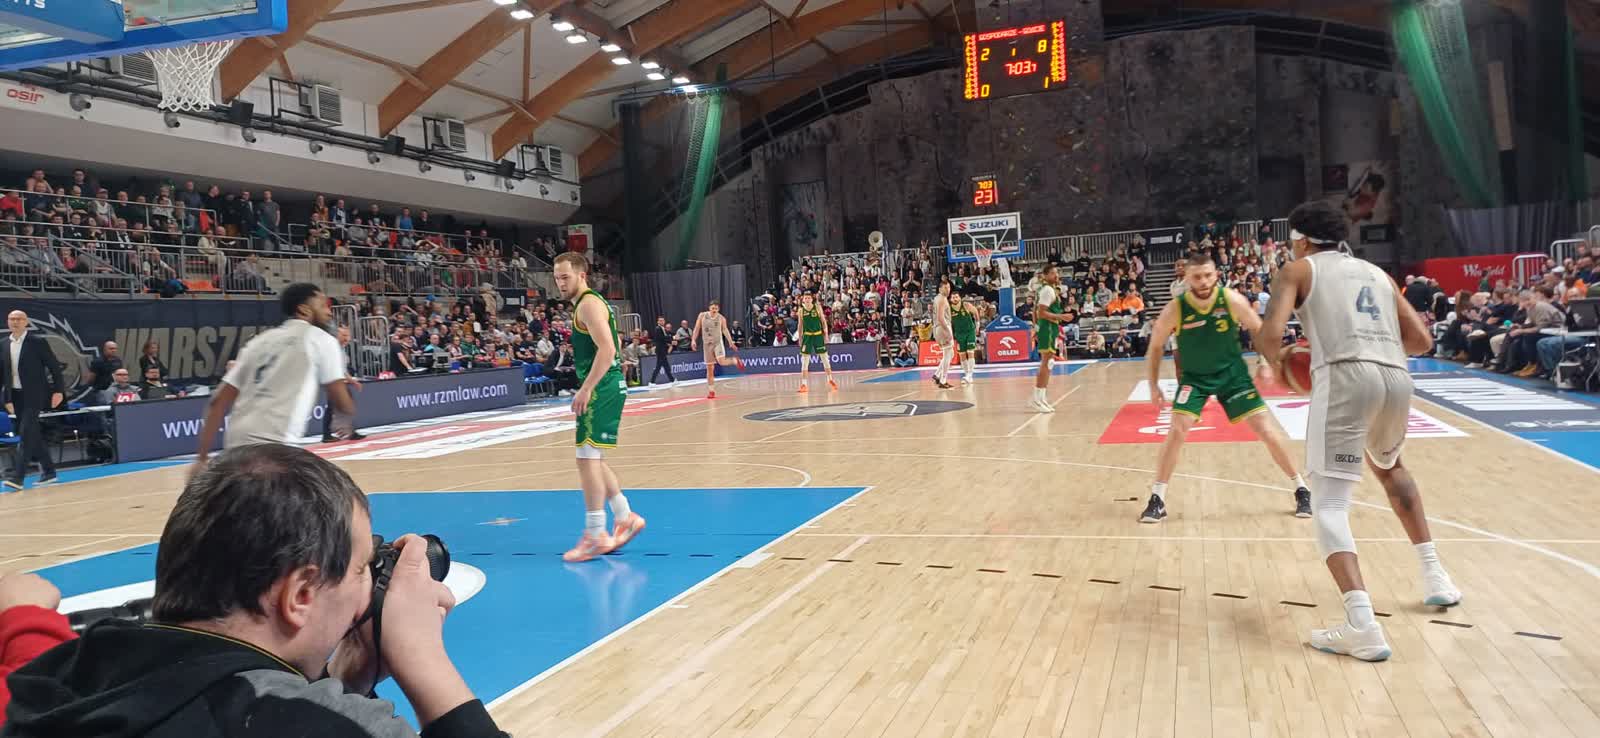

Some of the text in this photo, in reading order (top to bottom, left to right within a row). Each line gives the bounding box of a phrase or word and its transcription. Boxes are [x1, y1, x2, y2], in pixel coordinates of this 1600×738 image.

[981, 39, 1047, 61] 2 1 8
[7, 88, 45, 102] osir
[981, 84, 990, 98] 0
[974, 189, 993, 205] 23
[969, 220, 1009, 230] SUZUKI
[1355, 286, 1381, 321] 4
[1215, 319, 1230, 333] 3
[740, 352, 853, 368] www.rzmlw.om
[396, 383, 508, 409] www.rzmlaw.com
